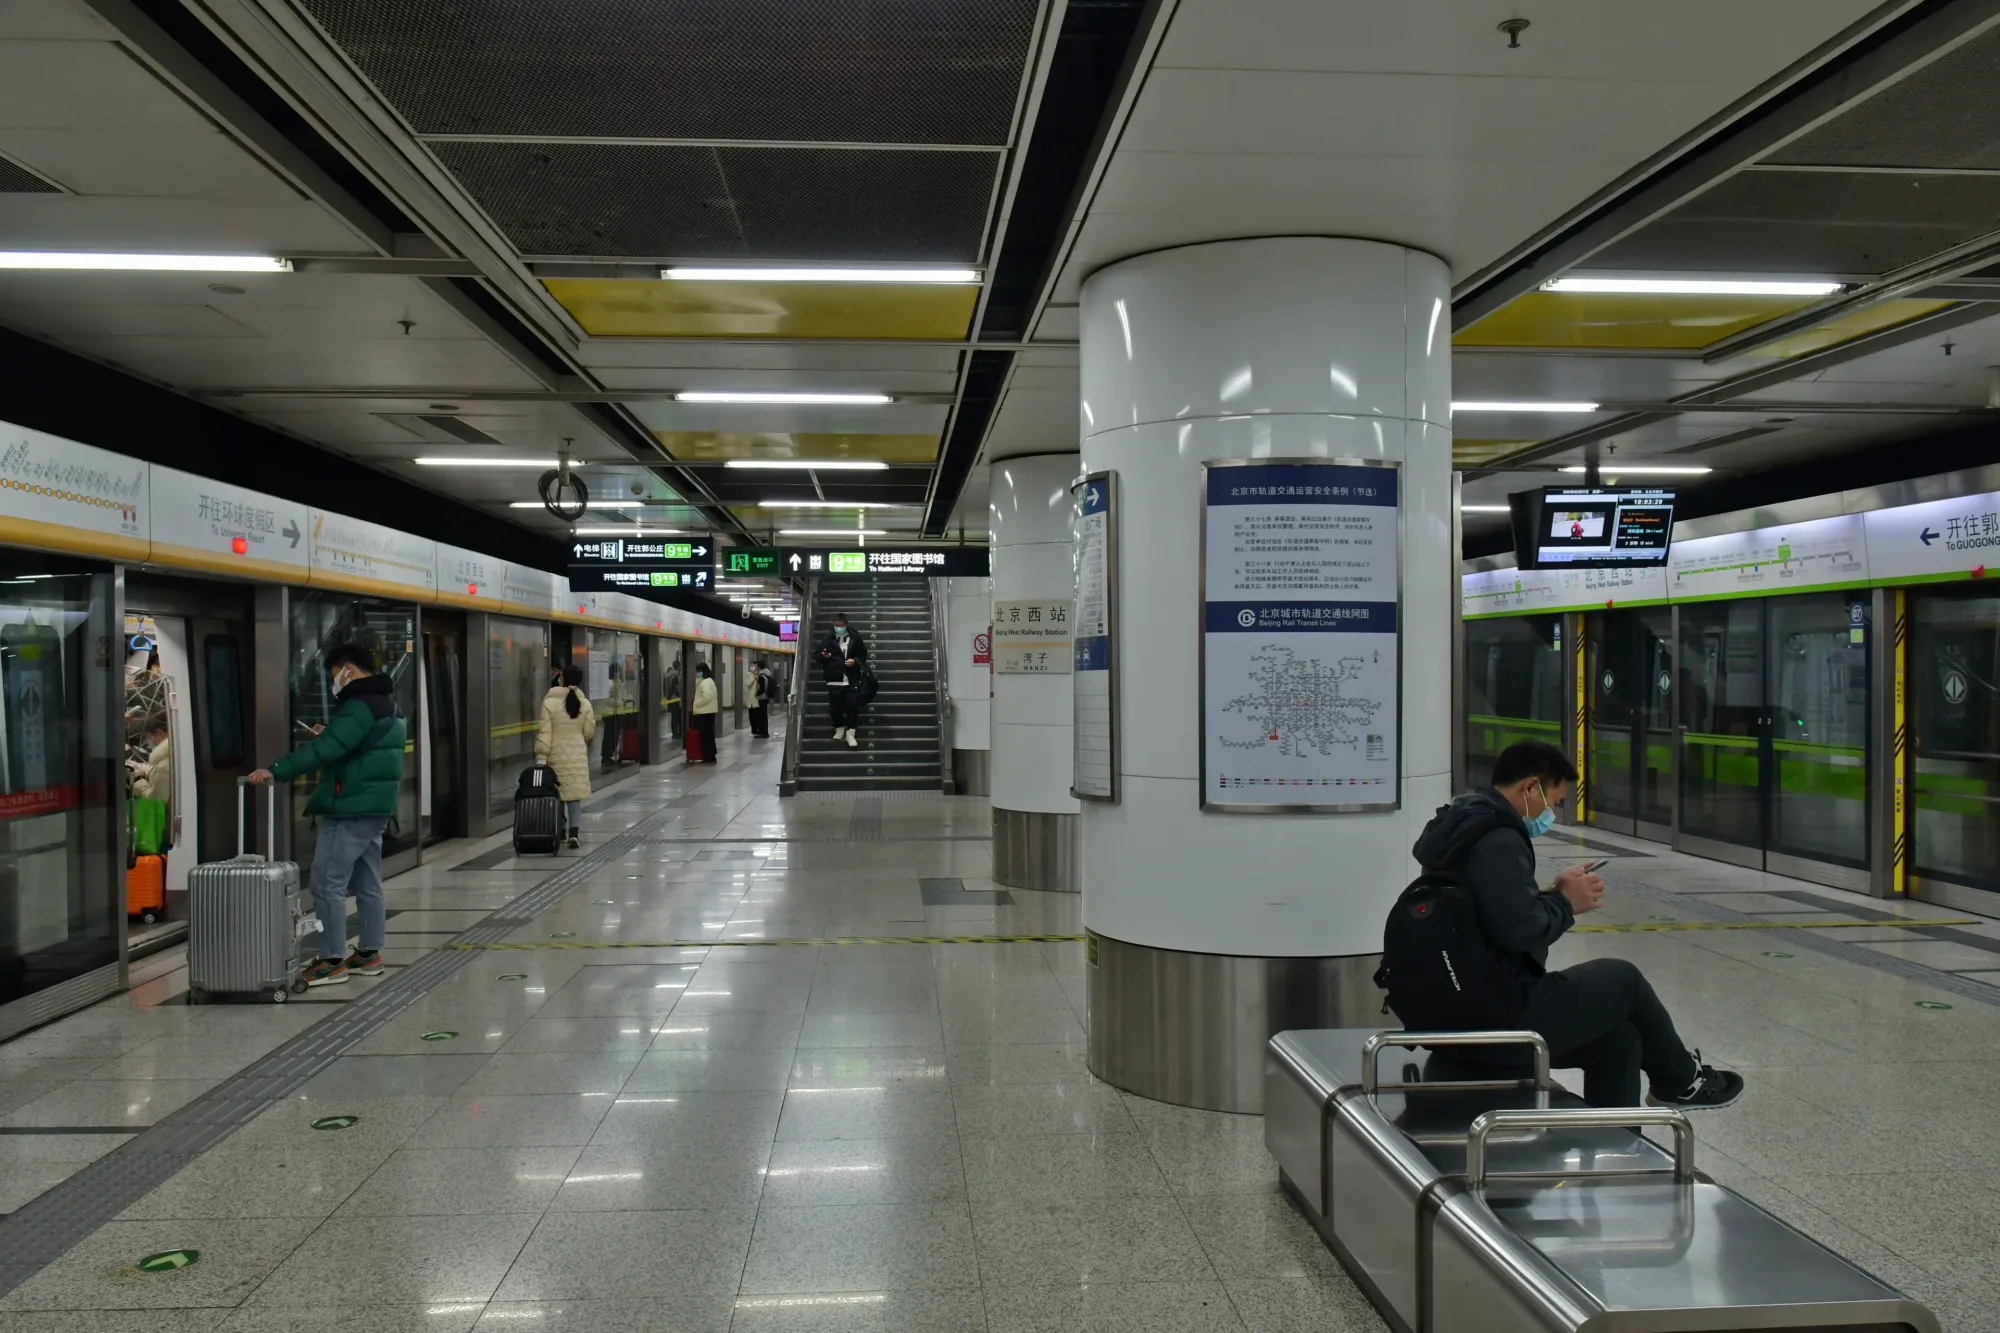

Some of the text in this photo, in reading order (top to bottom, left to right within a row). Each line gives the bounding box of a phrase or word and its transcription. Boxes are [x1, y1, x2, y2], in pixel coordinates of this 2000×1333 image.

[1231, 486, 1377, 497] 北京市轨道交通运营安全条例（节选）
[198, 494, 275, 534] 开往环球度假区
[212, 524, 219, 536] To
[1946, 512, 1999, 540] 开往郭
[584, 544, 600, 552] 电梯
[627, 544, 664, 553] 开往郭公庄
[1946, 535, 2000, 551] To GUOGONG
[668, 546, 676, 556] 9
[833, 555, 844, 570] 9
[869, 553, 945, 565] 开往国家图书馆
[904, 565, 925, 573] Library
[603, 573, 650, 581] 开往国家图书馆
[653, 574, 661, 585] 9
[996, 606, 1066, 623] 北京西站
[1259, 608, 1370, 619] 北京城市轨道交通线网图
[1259, 619, 1281, 627] Beijing
[1021, 628, 1043, 637] Railway
[1044, 628, 1068, 636] Station
[1023, 652, 1047, 664] 湾子
